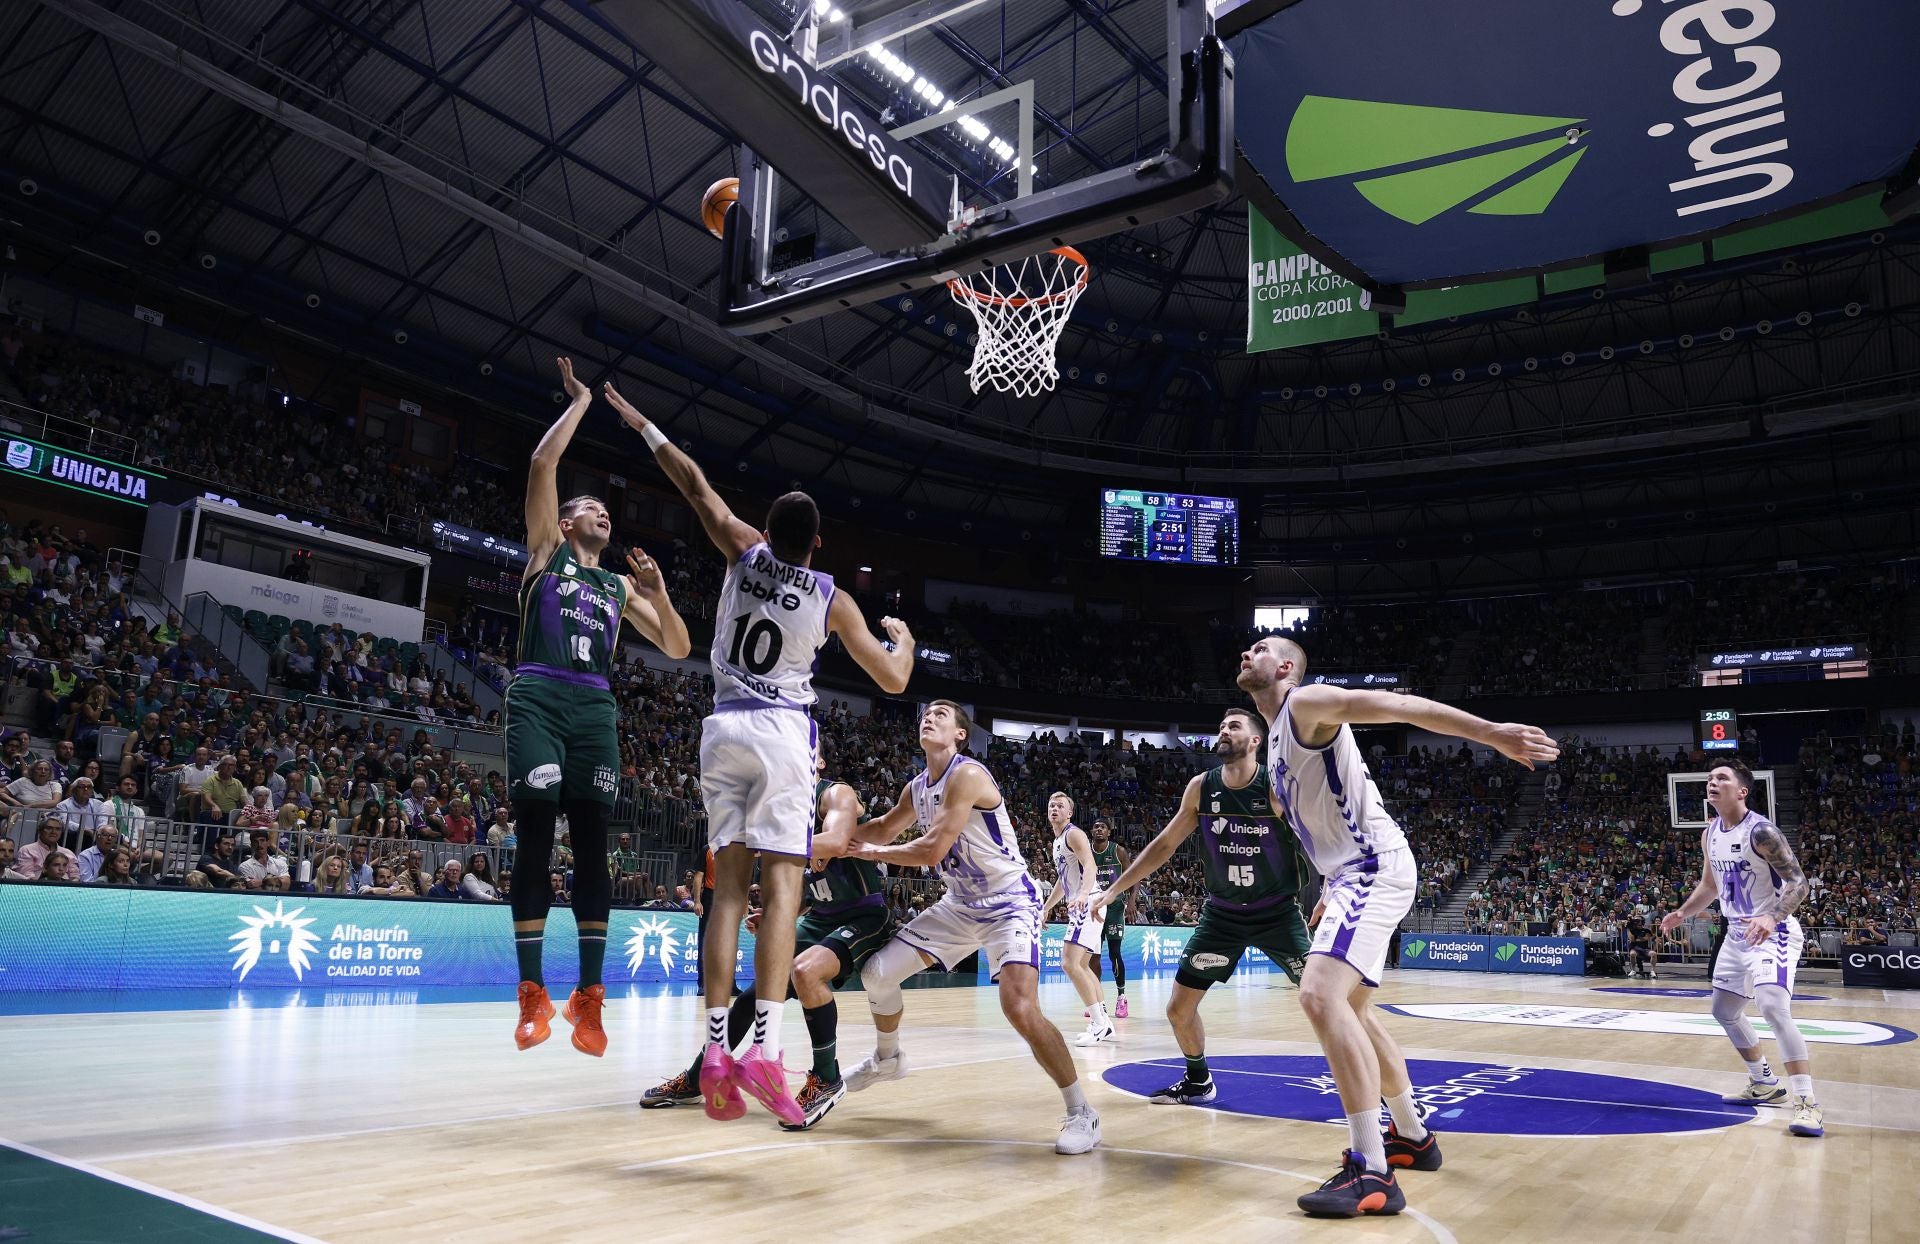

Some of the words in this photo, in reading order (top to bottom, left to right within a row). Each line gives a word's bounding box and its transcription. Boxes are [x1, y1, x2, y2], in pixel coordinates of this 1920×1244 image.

[750, 30, 912, 198] endesa
[1612, 0, 1794, 217] Unica
[1257, 282, 1302, 302] COPA
[1307, 274, 1355, 293] KORA
[1272, 297, 1352, 324] 2000/2001
[52, 455, 147, 500] UNICAJA
[1147, 496, 1159, 505] 58
[1165, 497, 1176, 506] VS
[1182, 498, 1194, 508] 53
[1161, 522, 1183, 533] 2:51
[1156, 543, 1161, 552] 3
[739, 576, 779, 605] bbk
[560, 606, 605, 632] málaga
[570, 634, 592, 662] 19
[728, 611, 783, 676] 10
[1326, 677, 1348, 685] Unicaja
[1375, 675, 1398, 684] Unicaja
[1705, 711, 1730, 721] 2:50
[1712, 723, 1726, 741] 8
[1229, 823, 1270, 837] Unicaja
[1219, 841, 1261, 857] málaga
[1228, 865, 1255, 887] 45
[330, 924, 409, 942] Alhaurín
[329, 943, 353, 961] de
[357, 943, 372, 961] la
[377, 943, 423, 961] Torre
[1046, 938, 1064, 949] Alhau
[1429, 941, 1484, 953] Fundación
[1520, 944, 1579, 957] Fundación
[684, 948, 698, 961] de
[1429, 951, 1469, 963] Unicaja
[1520, 954, 1563, 967] Unicaja
[1848, 949, 1920, 970] ende
[327, 965, 377, 977] CALIDAD
[379, 965, 393, 977] DE
[396, 965, 421, 977] VIDA
